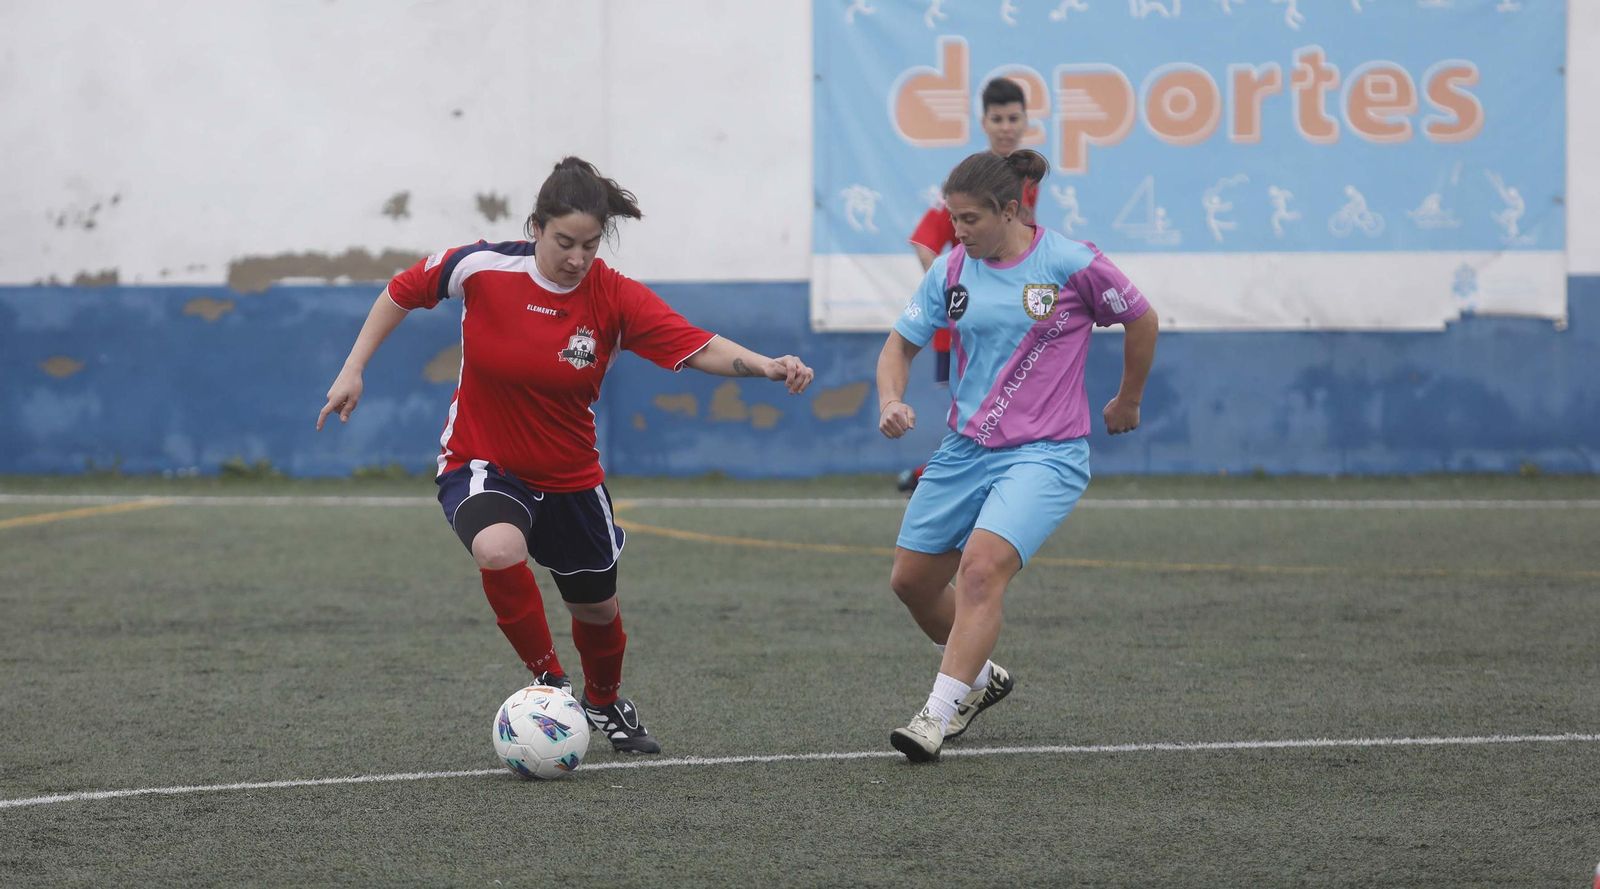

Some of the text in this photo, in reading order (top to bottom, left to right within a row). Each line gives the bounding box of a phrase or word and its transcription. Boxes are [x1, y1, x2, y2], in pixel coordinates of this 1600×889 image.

[891, 35, 1484, 173] deportes
[527, 303, 557, 316] ELEMENTS
[1004, 310, 1070, 398] ALCOBENDAS
